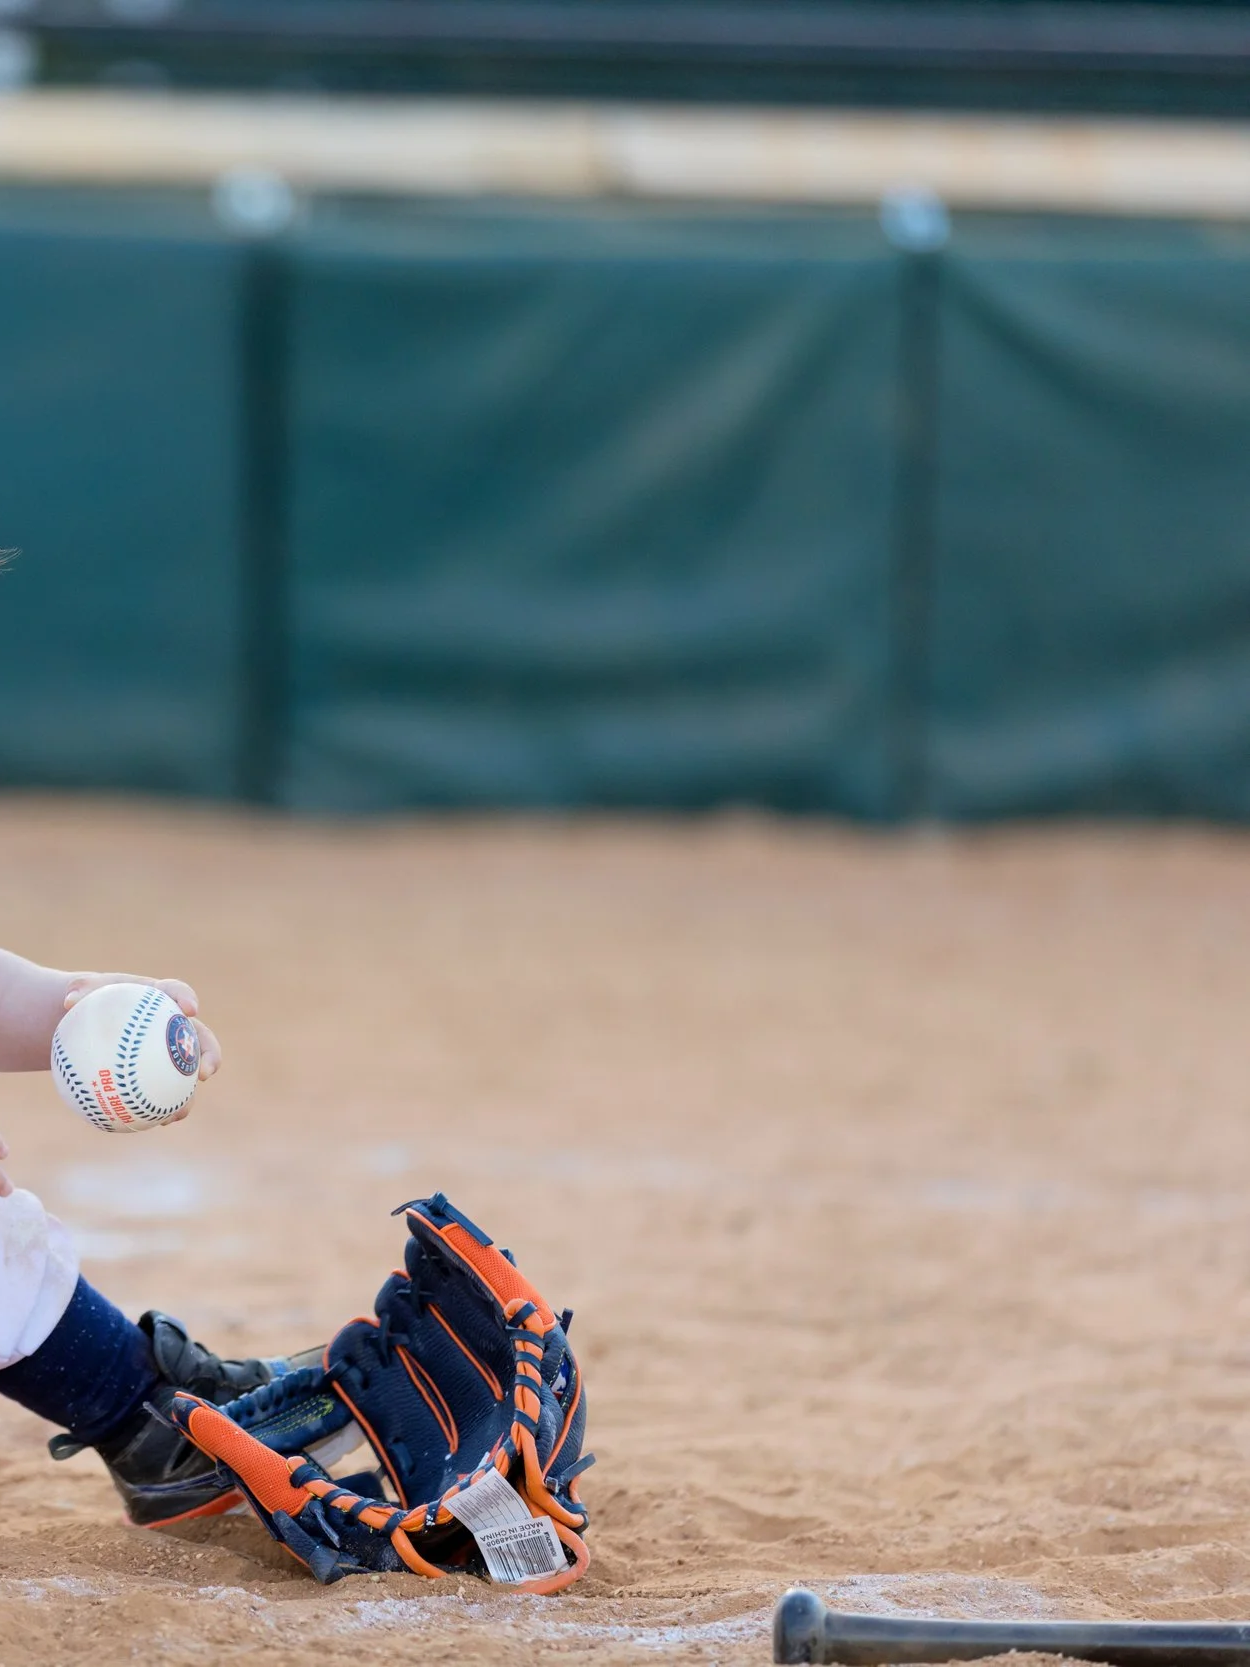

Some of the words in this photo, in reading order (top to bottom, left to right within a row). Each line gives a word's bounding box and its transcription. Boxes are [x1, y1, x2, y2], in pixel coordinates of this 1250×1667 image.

[98, 1069, 116, 1093] PRO
[95, 1090, 113, 1118] OFFICIAL
[107, 1094, 135, 1124] FUTURE
[508, 1527, 517, 1535] IN
[519, 1521, 544, 1532] MADE
[480, 1530, 507, 1542] CHINA
